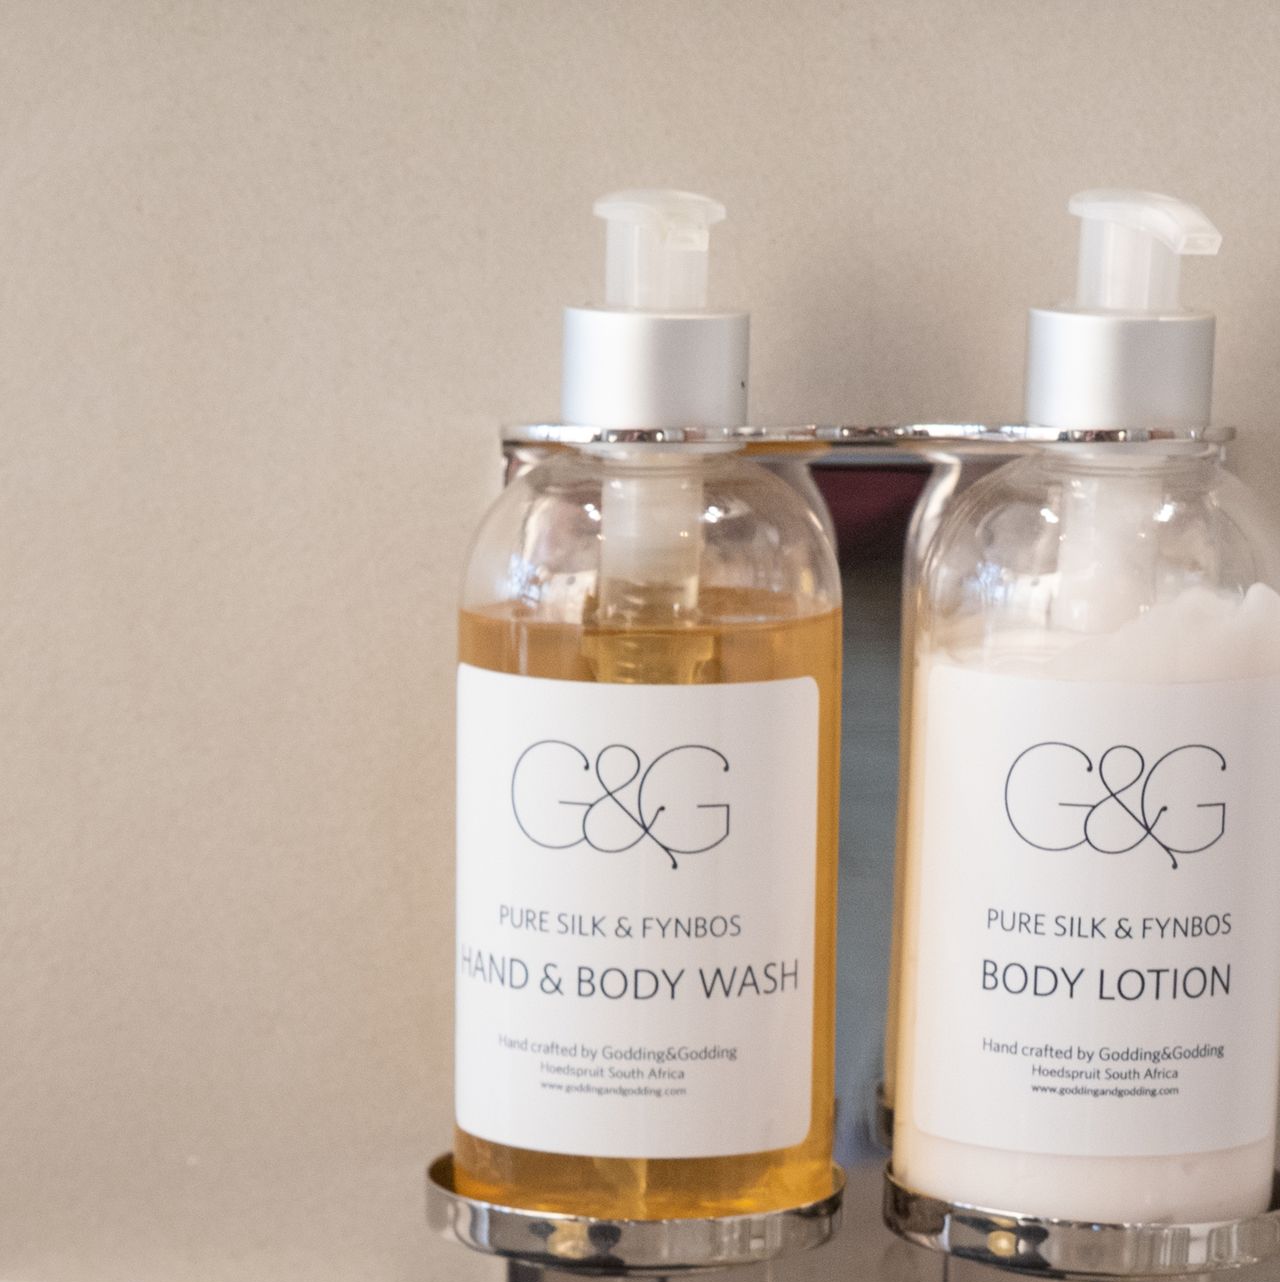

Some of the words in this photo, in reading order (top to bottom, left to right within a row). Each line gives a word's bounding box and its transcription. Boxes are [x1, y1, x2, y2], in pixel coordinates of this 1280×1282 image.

[511, 740, 730, 869] G&G
[1005, 741, 1226, 870] G&G
[499, 904, 550, 933] PURE
[557, 912, 606, 938] SILK
[614, 916, 633, 938] &
[642, 914, 742, 939] FYNBOS
[987, 908, 1046, 936] PURE
[1054, 915, 1107, 939] SILK
[1114, 917, 1133, 939] &
[1142, 912, 1232, 939] FYNBOS
[461, 943, 529, 990] HAND
[540, 963, 564, 996] &
[577, 966, 685, 1000] BODY
[698, 958, 799, 998] WASH
[982, 959, 1085, 999] BODY
[1099, 963, 1231, 1001] LOTION
[498, 1034, 528, 1052] Hand
[531, 1040, 577, 1058] crafted
[581, 1044, 598, 1061] by
[602, 1044, 738, 1063] Godding&Godding
[982, 1037, 1018, 1055] Hand
[1021, 1043, 1073, 1060] crafted
[1077, 1045, 1094, 1063] by
[1098, 1043, 1225, 1063] Godding&Godding
[540, 1060, 604, 1078] Hoedspruit
[608, 1066, 644, 1080] South
[648, 1067, 685, 1080] Africa
[1031, 1063, 1100, 1081] Hoedspruit
[1104, 1066, 1140, 1080] South
[1144, 1067, 1179, 1080] Africa
[1031, 1083, 1179, 1098] www.goddingandgodding.com
